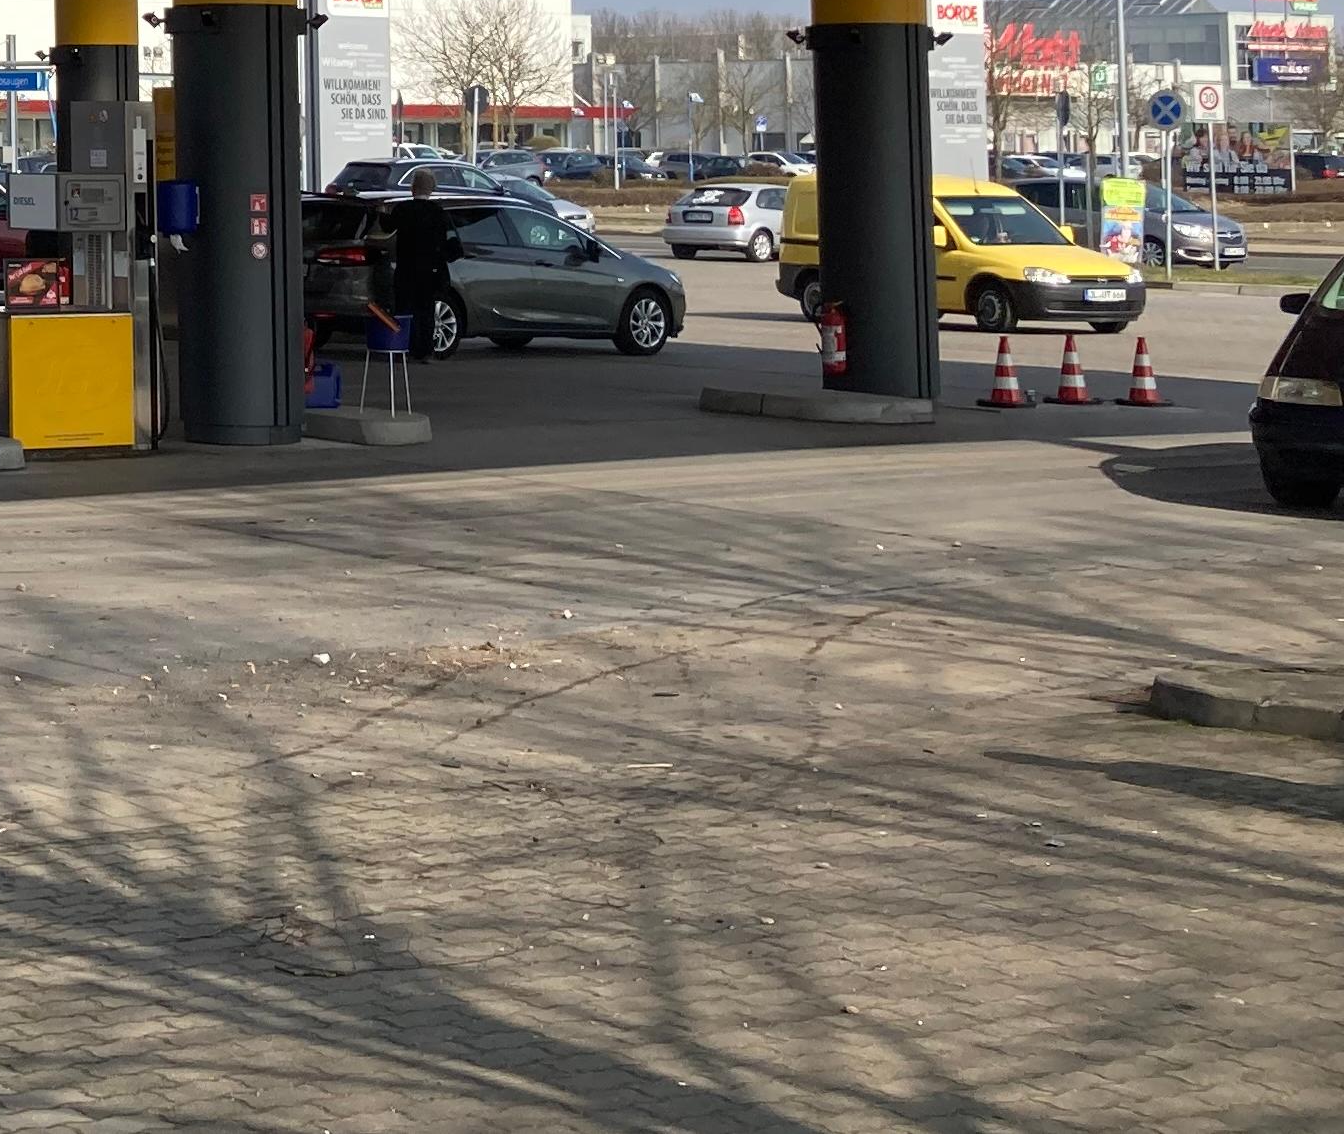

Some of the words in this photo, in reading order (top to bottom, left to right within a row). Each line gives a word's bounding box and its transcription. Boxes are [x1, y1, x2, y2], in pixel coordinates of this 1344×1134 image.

[323, 78, 381, 91] WILLKOMMEN!
[330, 91, 360, 106] SCHÖN,
[361, 94, 382, 106] DASS
[1203, 92, 1216, 104] 30
[341, 108, 354, 120] SIE
[355, 108, 366, 120] DA
[367, 108, 388, 120] SIND.
[13, 197, 36, 206] DIESEL
[69, 208, 80, 220] 12
